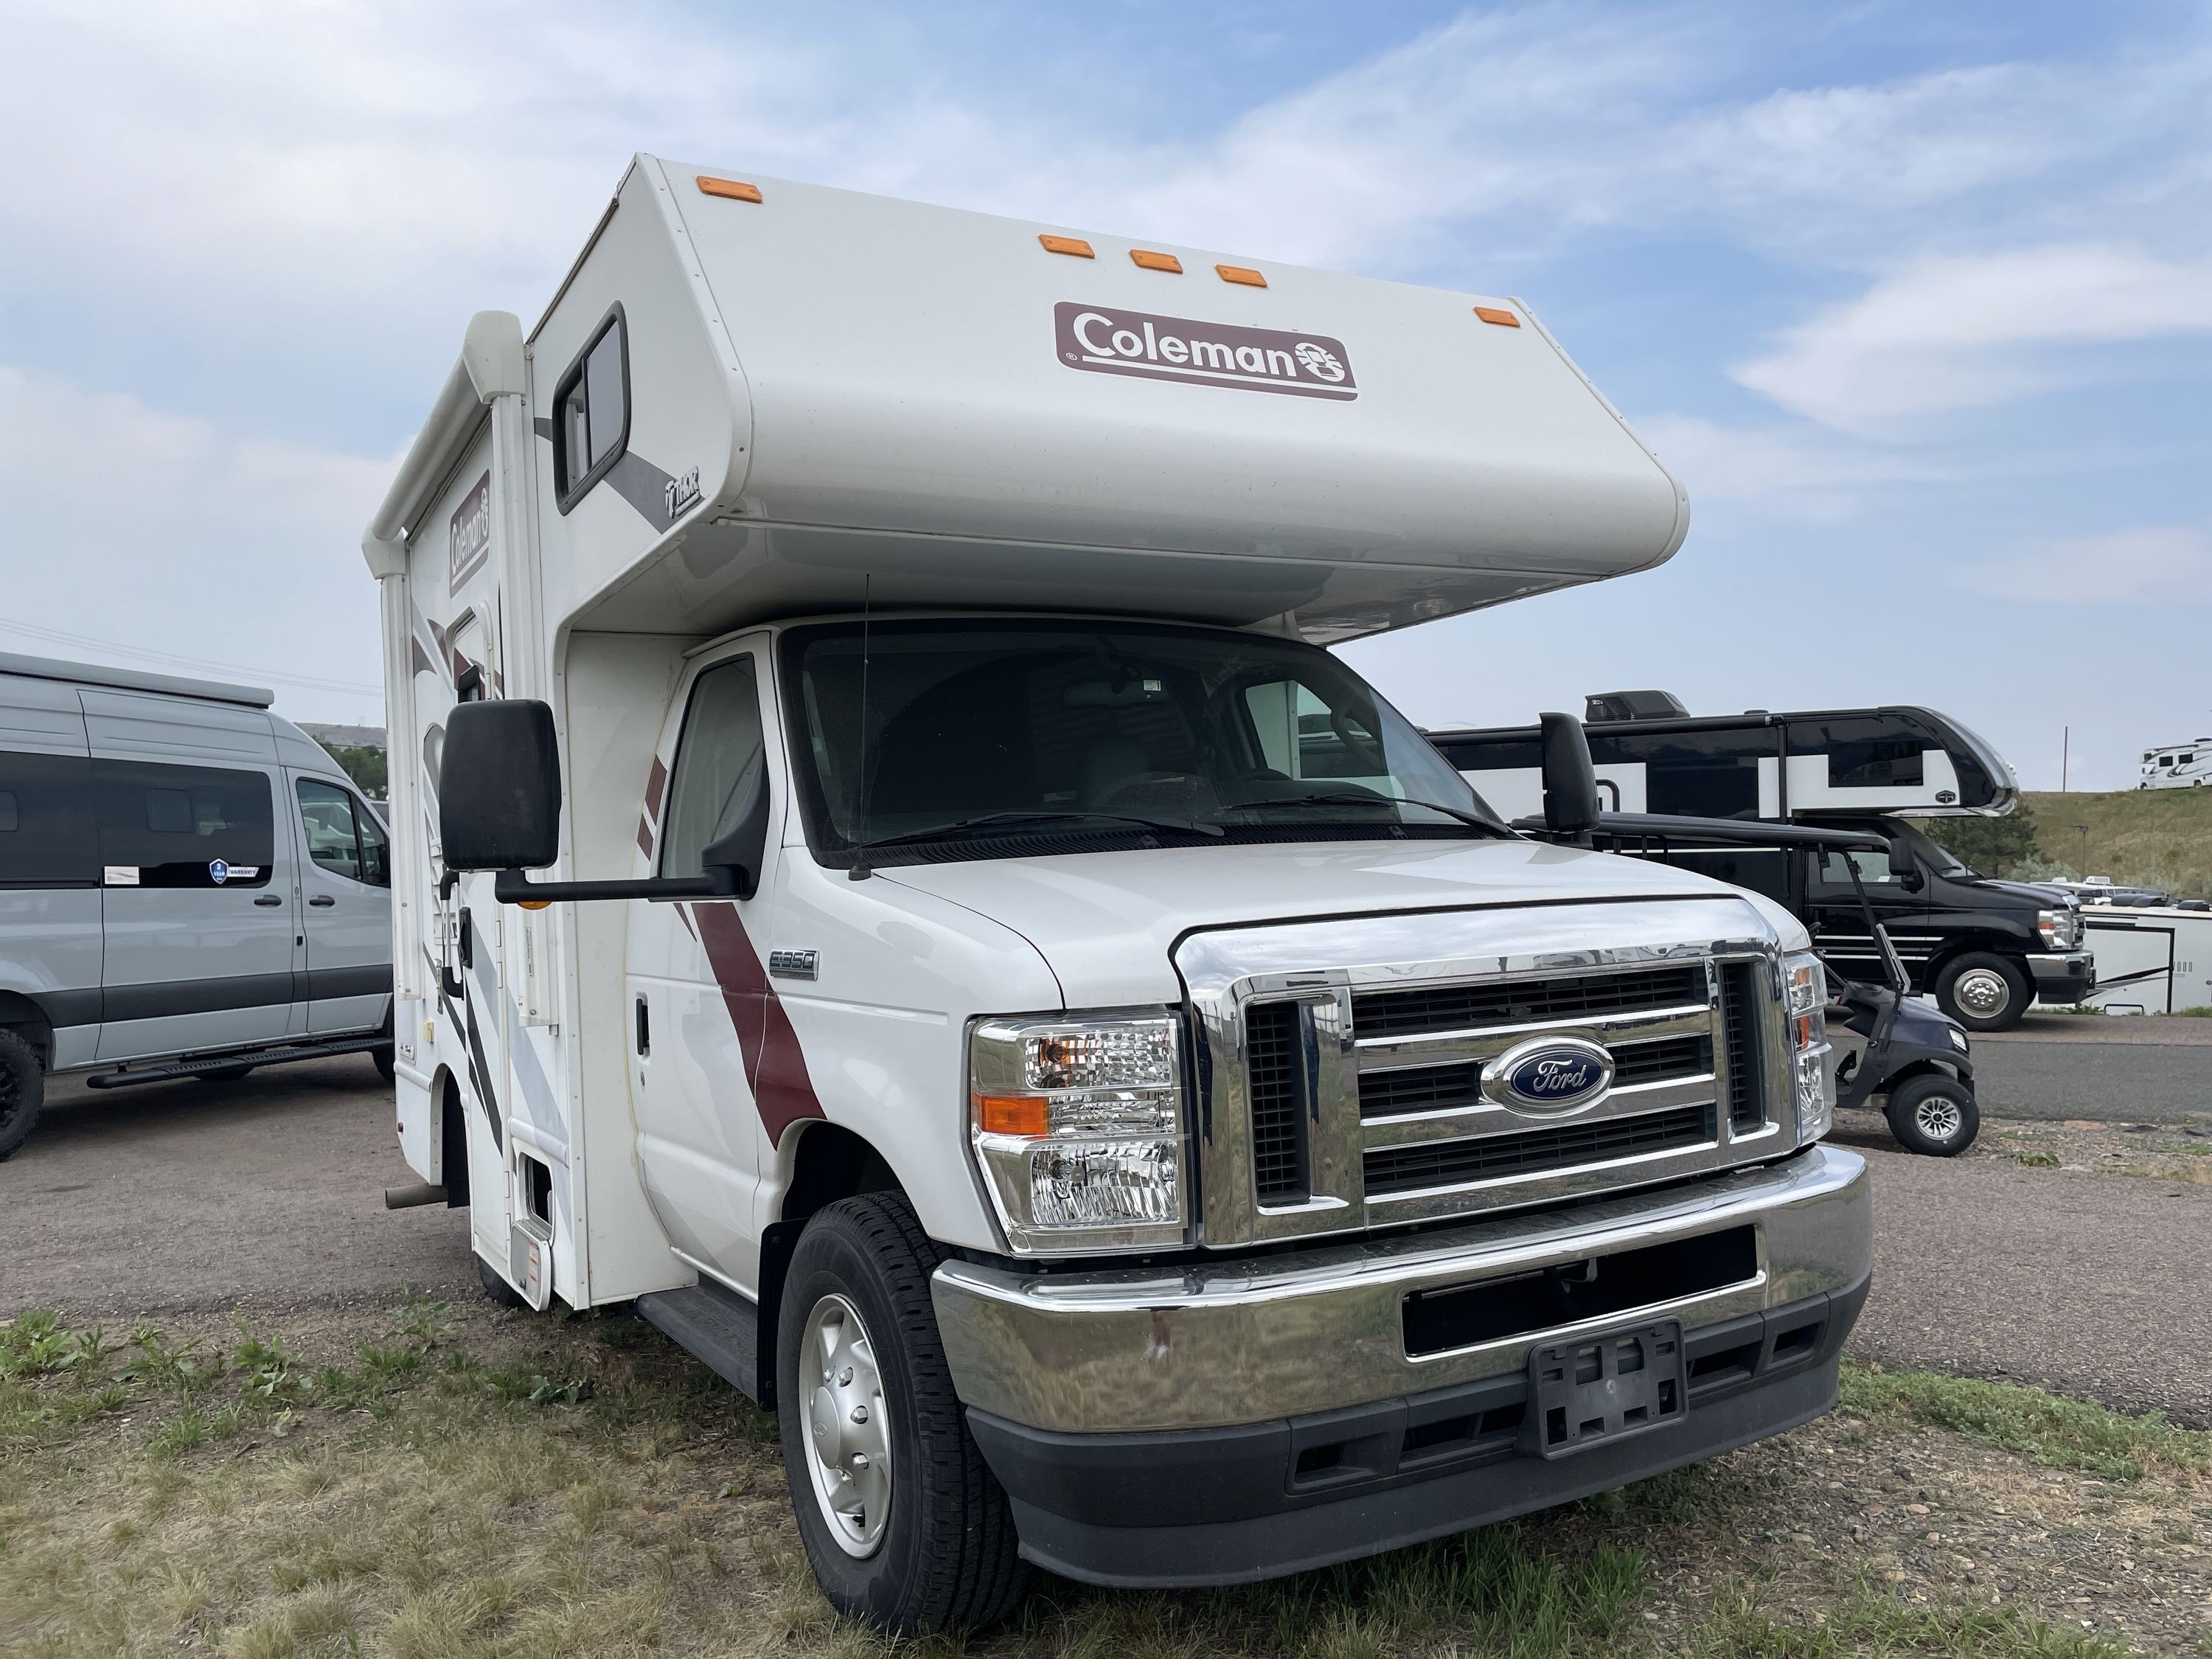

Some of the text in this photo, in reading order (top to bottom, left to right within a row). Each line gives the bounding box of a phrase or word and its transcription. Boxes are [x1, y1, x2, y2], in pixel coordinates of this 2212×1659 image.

[1073, 312, 1298, 377] Coleman
[451, 509, 481, 575] Coleman
[1532, 1059, 1587, 1092] Ford
